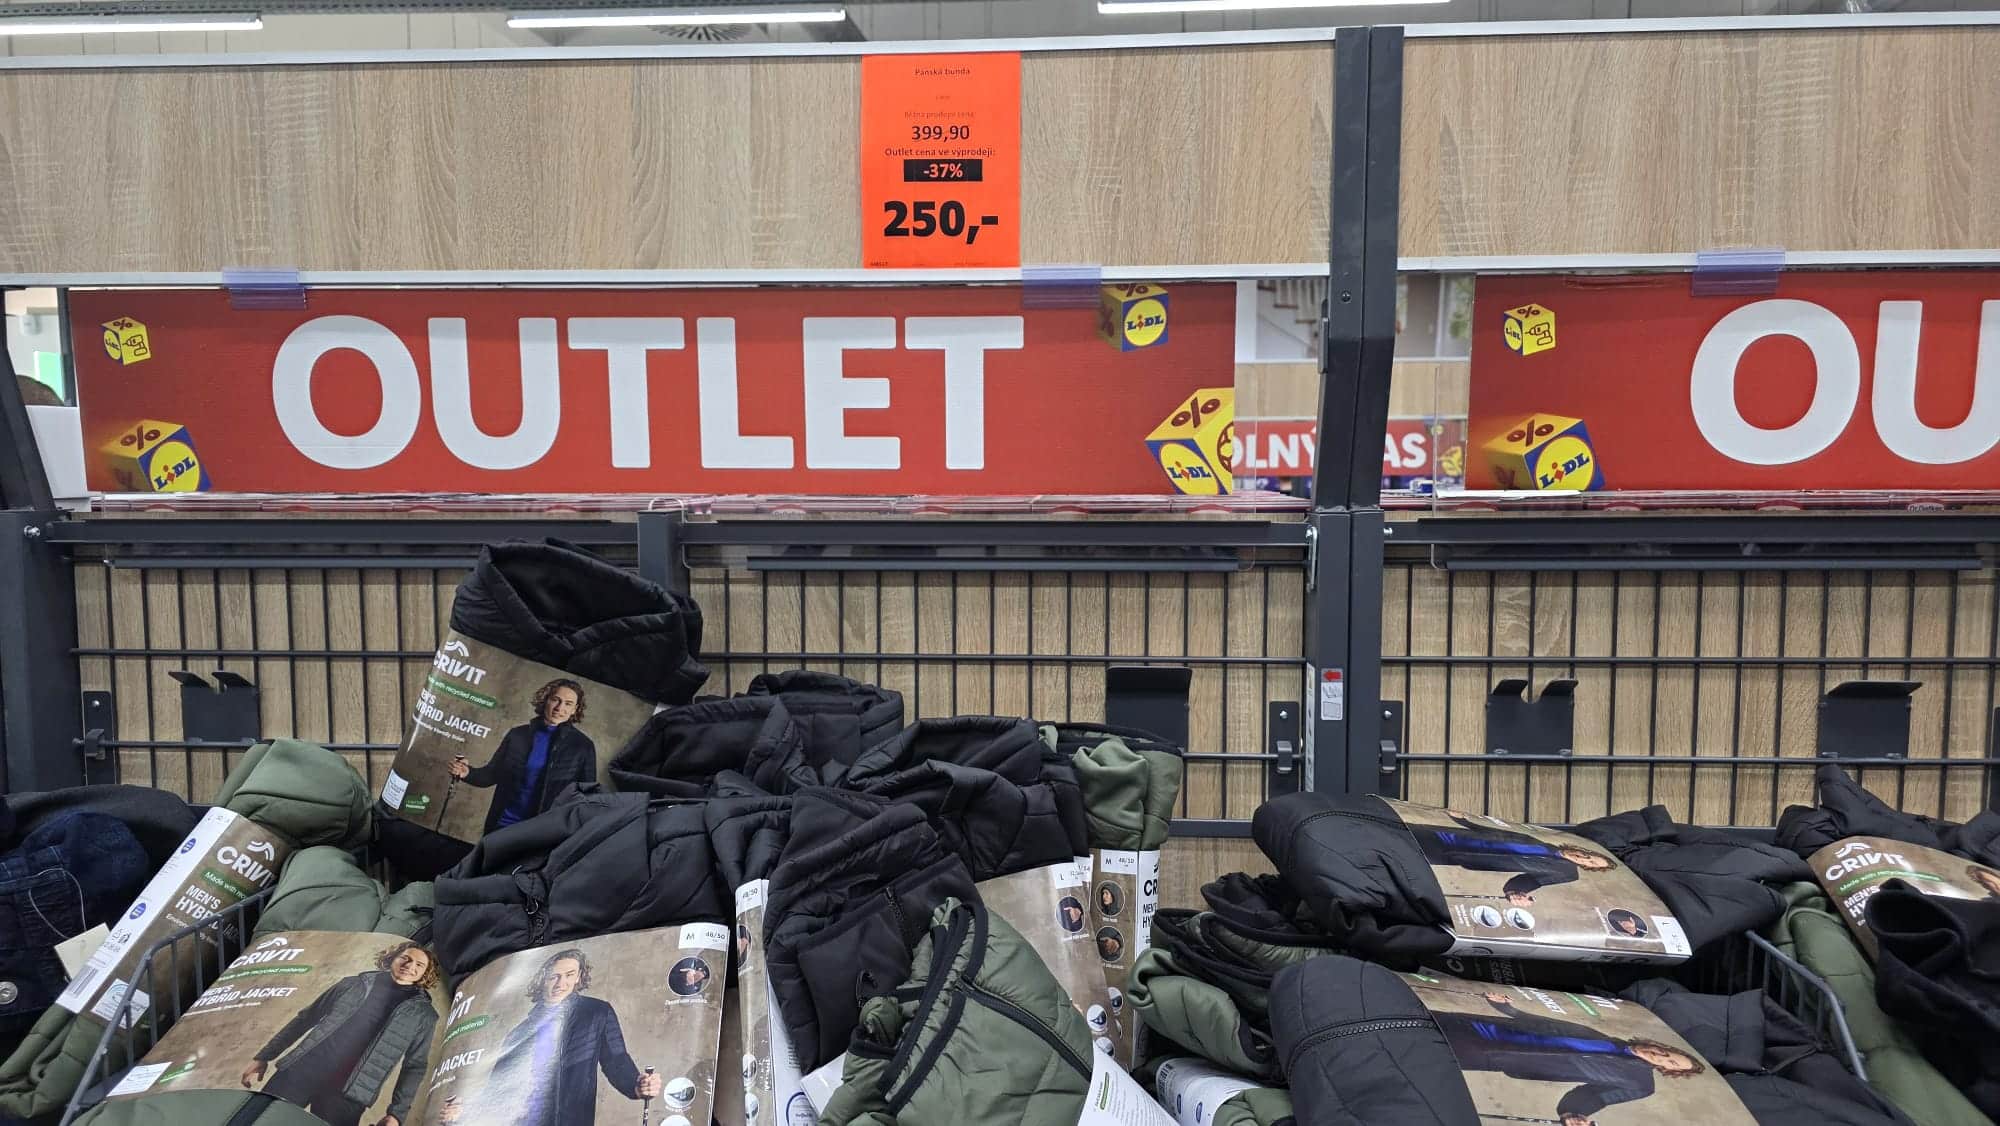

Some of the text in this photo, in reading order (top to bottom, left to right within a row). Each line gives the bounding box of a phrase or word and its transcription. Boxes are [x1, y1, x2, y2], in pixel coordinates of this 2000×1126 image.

[912, 125, 970, 143] 399,90
[884, 148, 913, 156] Outlet
[923, 163, 963, 178] -37%
[883, 200, 999, 245] 250,-
[271, 314, 1025, 473] OUTLET
[444, 715, 491, 738] JACKET
[1825, 852, 1908, 881] CRIVIT
[186, 884, 220, 910] MEN'S
[1844, 886, 1880, 908] MEN'S
[228, 949, 304, 969] CRIVIT
[240, 987, 298, 999] JACKET
[436, 1048, 485, 1076] JACKET
